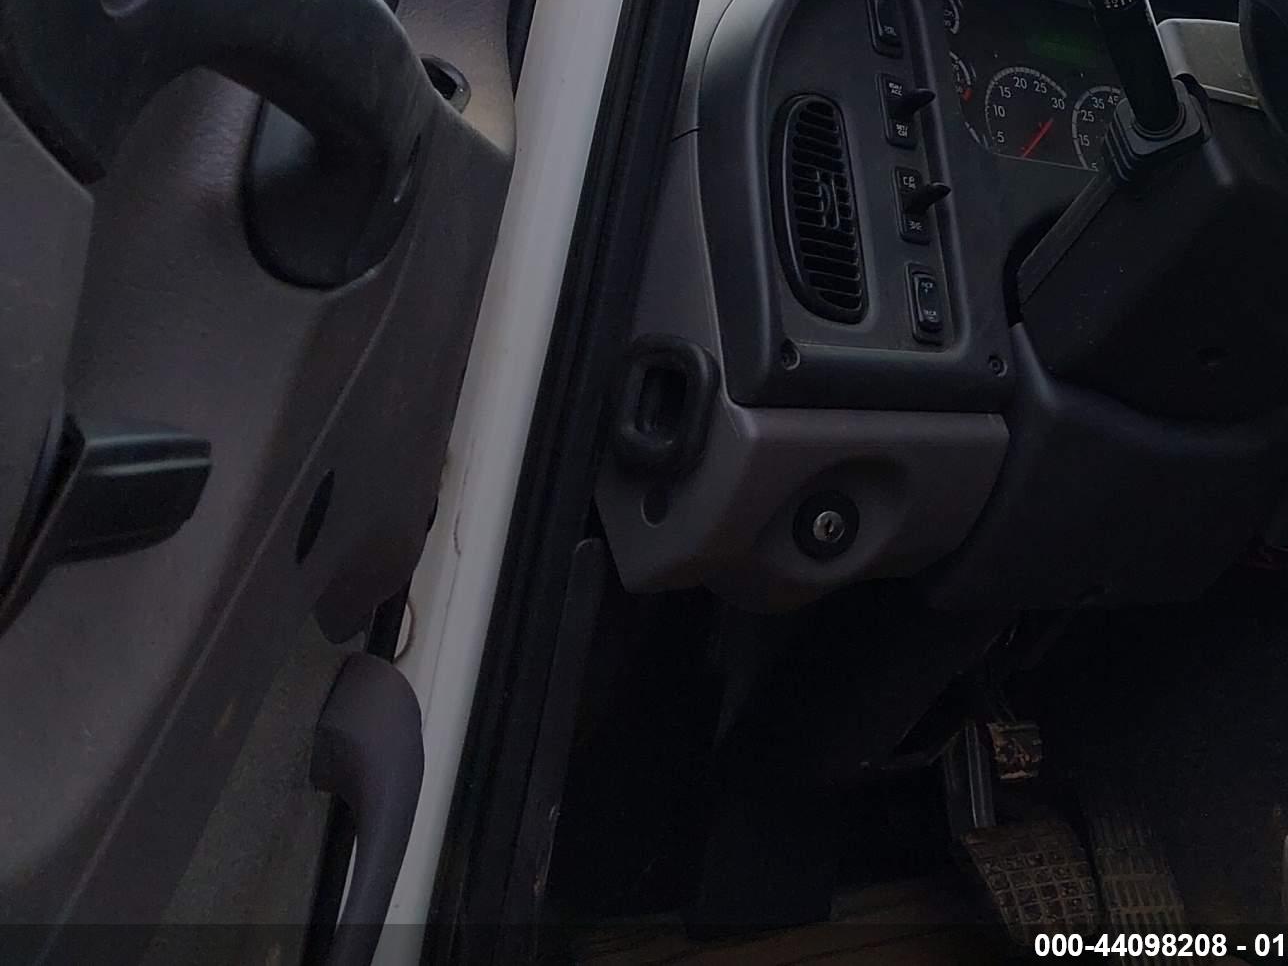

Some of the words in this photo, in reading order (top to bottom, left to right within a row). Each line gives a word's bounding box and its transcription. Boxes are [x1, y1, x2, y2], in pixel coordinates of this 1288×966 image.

[1013, 76, 1028, 89] 20
[1033, 81, 1047, 94] 25
[999, 85, 1012, 98] 15
[1050, 97, 1065, 110] 30
[1091, 97, 1105, 109] 35
[993, 105, 1006, 118] 10
[1080, 109, 1095, 123] 25
[997, 131, 1005, 144] 5
[1078, 134, 1090, 147] 15
